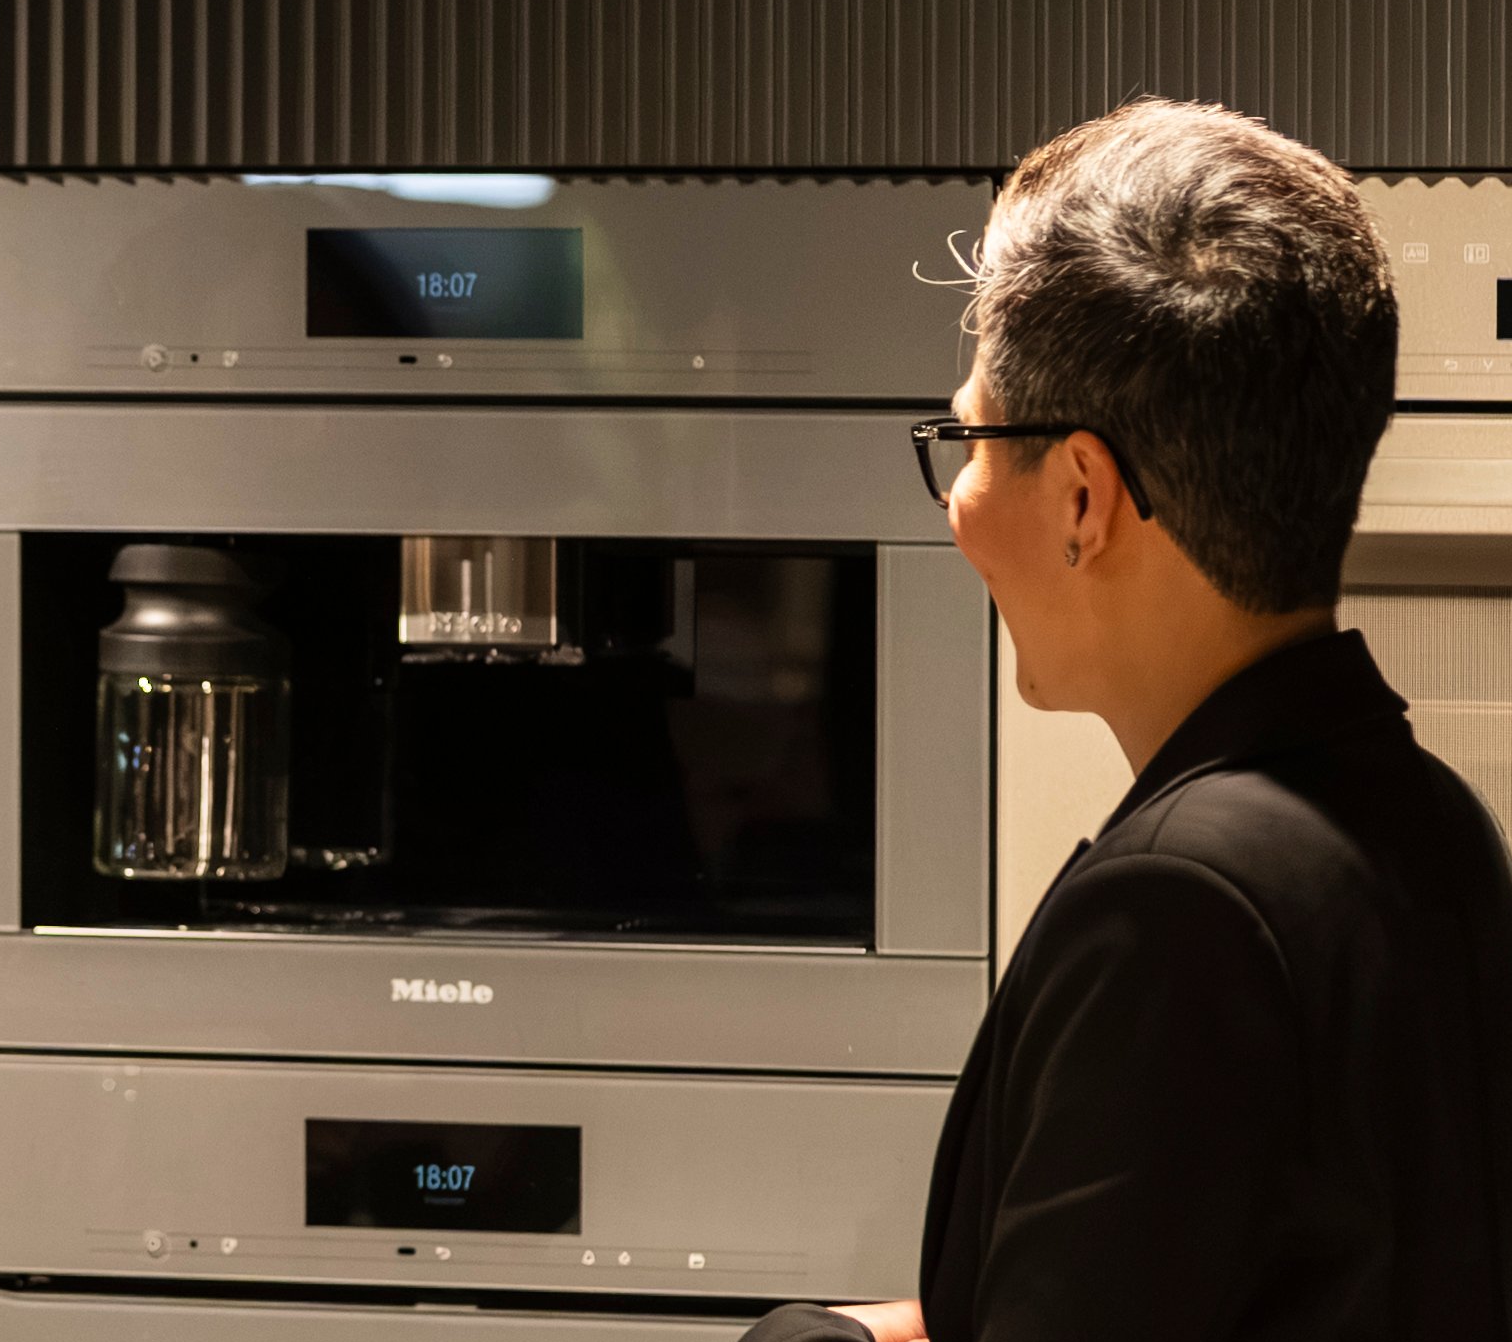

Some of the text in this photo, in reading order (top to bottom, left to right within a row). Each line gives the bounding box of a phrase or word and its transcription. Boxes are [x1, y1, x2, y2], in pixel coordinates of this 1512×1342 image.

[416, 272, 478, 298] 18:07
[391, 978, 494, 1004] Miele
[414, 1164, 476, 1190] 18:07
